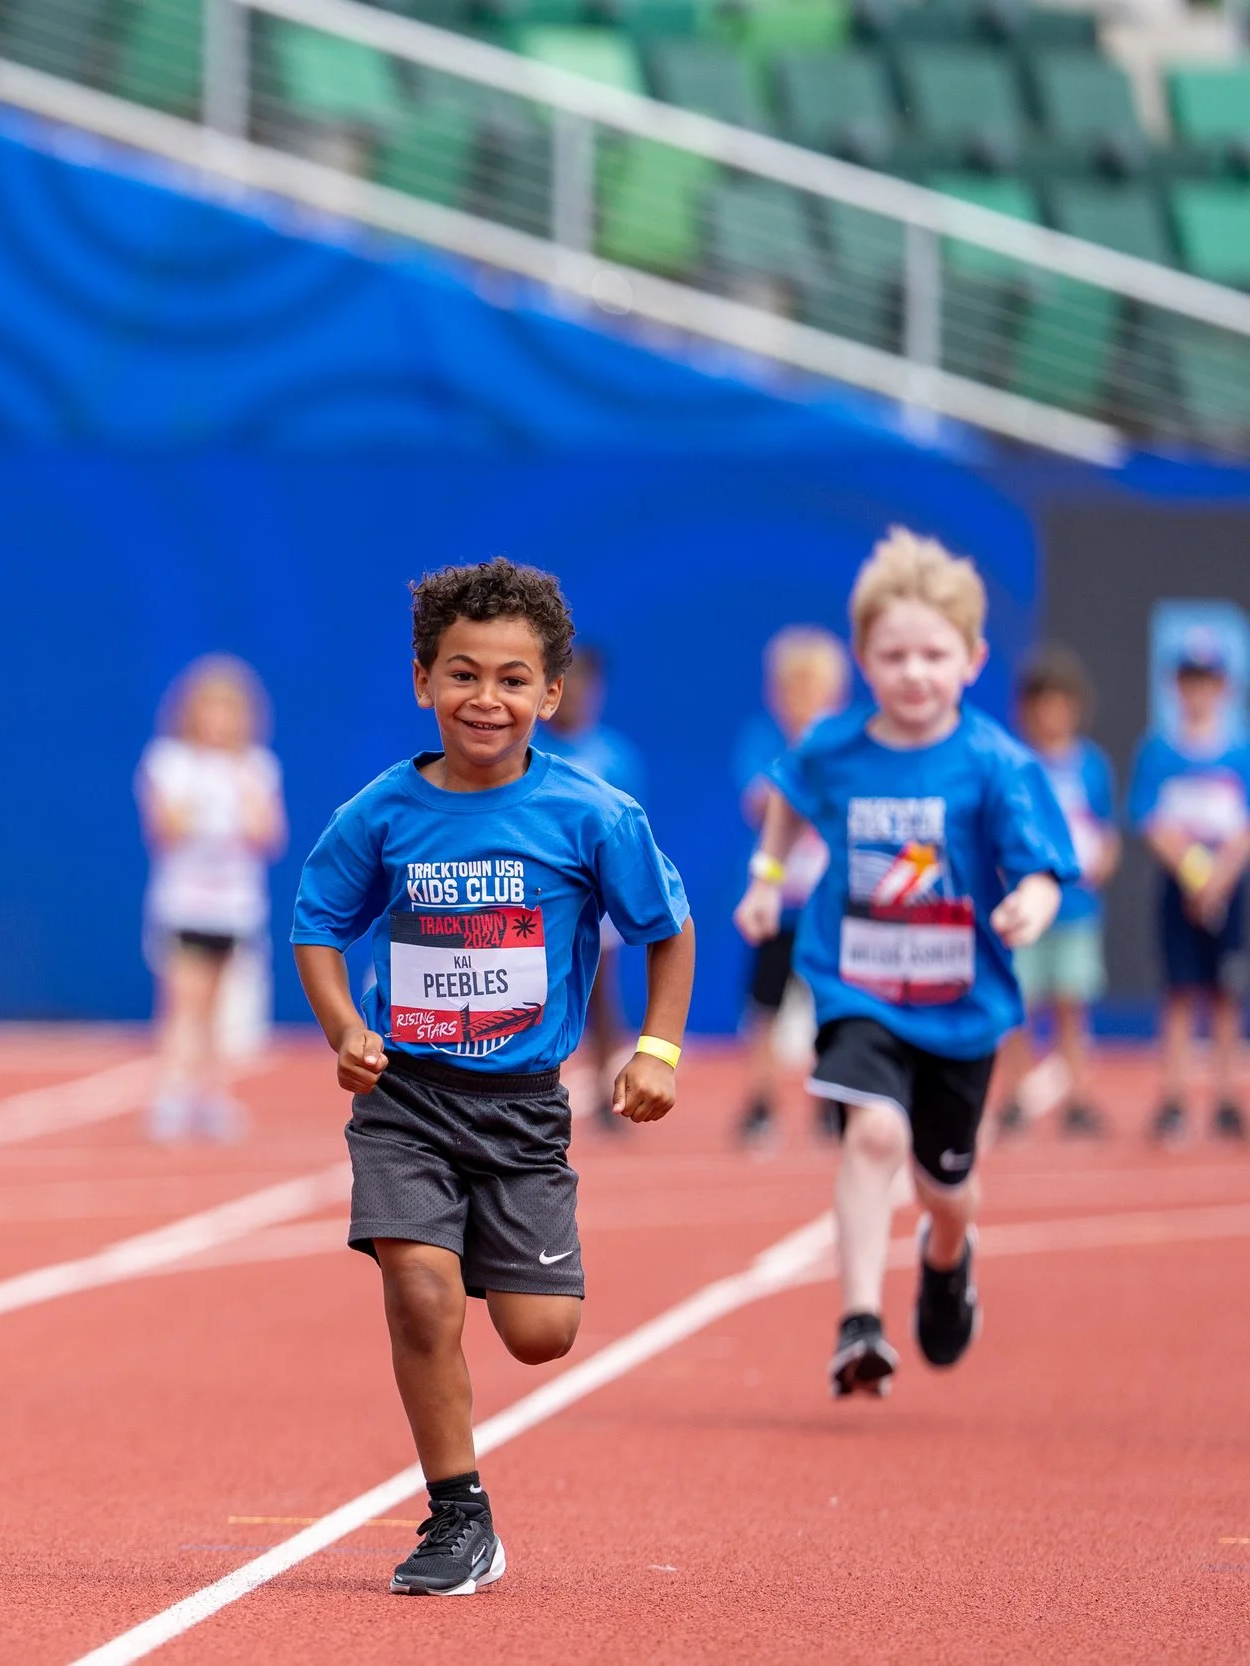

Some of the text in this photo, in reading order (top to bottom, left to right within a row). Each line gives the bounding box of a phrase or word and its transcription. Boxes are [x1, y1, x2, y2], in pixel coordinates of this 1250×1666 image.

[407, 860, 524, 879] TRACKTOWN USA
[407, 877, 525, 904] KIDS CLUB
[419, 913, 504, 936] TRACKTOWN
[463, 929, 501, 949] 2024
[454, 956, 472, 969] KAI
[424, 968, 509, 998] PEEBLES
[396, 1011, 435, 1027] RISING
[417, 1020, 458, 1040] STARS
